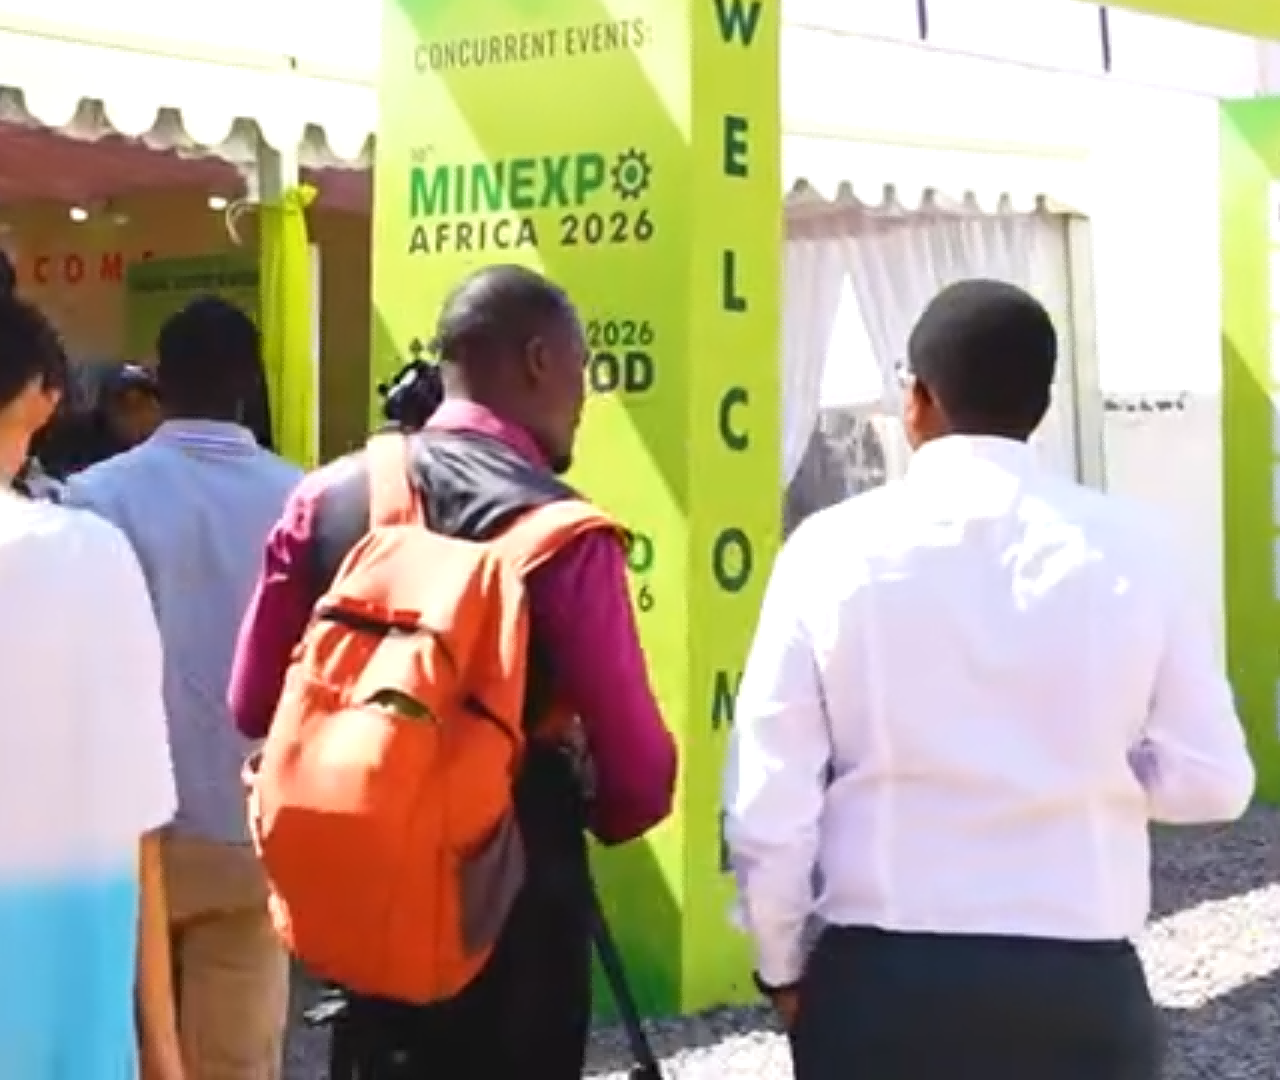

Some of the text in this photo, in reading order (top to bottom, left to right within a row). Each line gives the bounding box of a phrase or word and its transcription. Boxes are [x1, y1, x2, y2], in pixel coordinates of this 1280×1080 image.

[414, 18, 654, 73] CONCURRENT EVENTS:
[408, 210, 654, 255] AFRICA 2026
[586, 319, 655, 349] 2026
